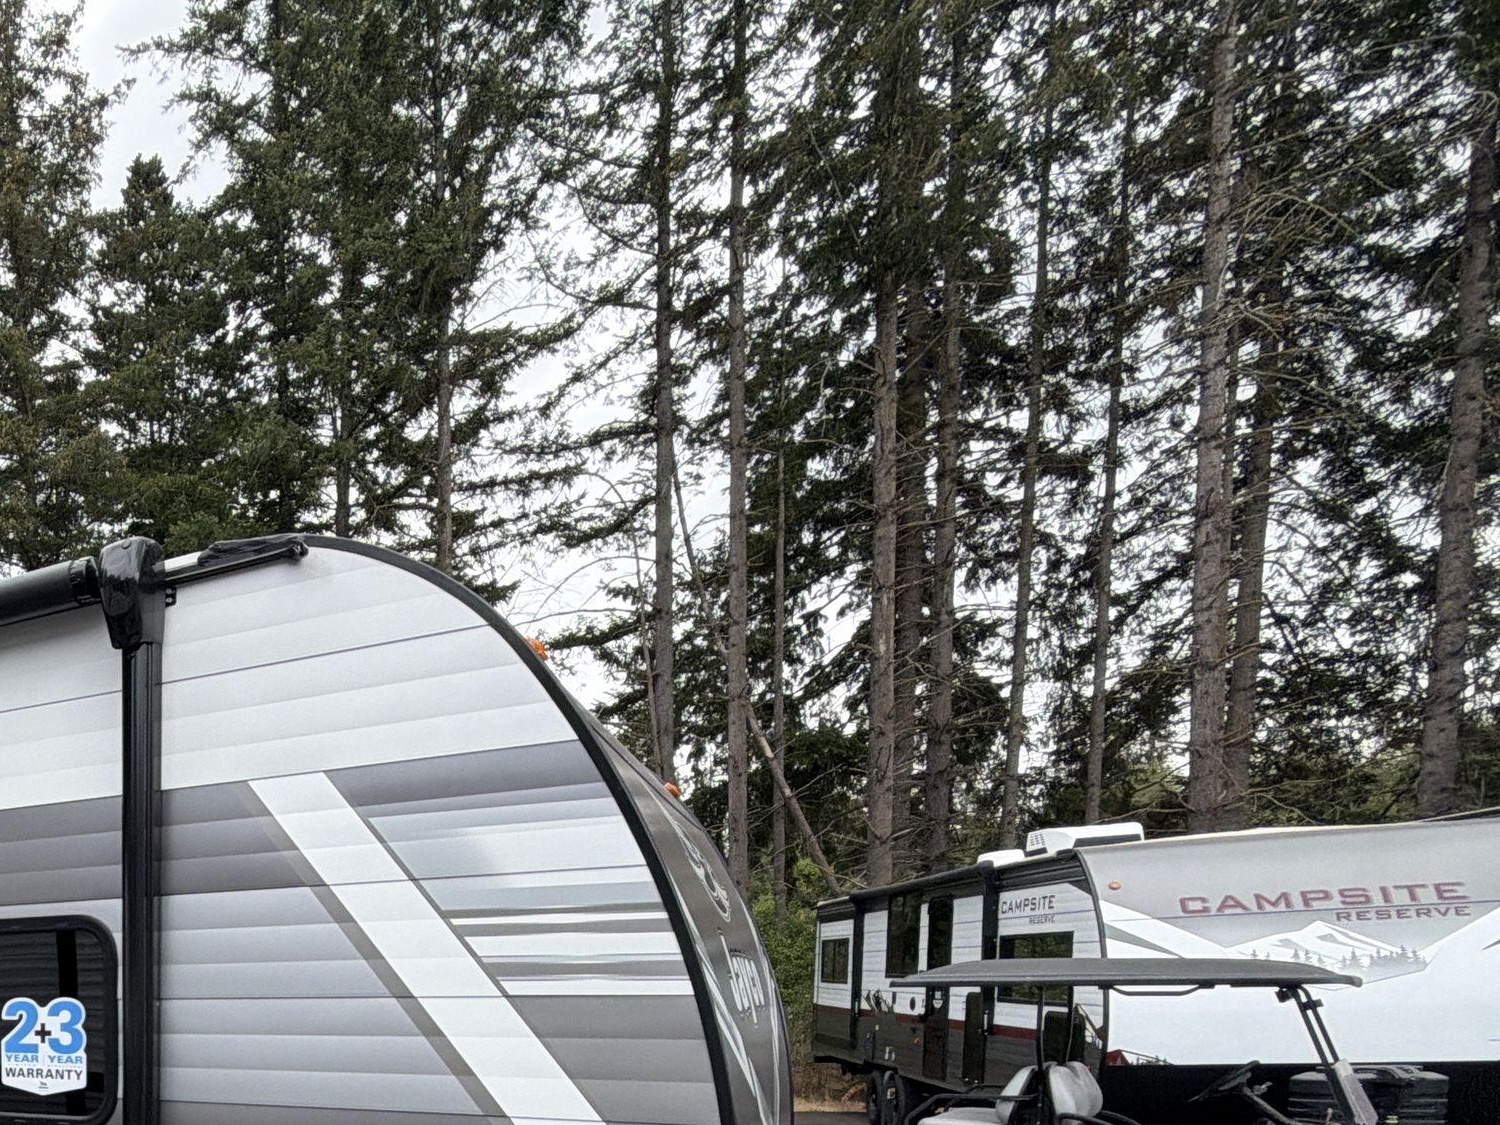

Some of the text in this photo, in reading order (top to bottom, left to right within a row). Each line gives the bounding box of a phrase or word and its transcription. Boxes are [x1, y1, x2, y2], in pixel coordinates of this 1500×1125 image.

[1001, 894, 1055, 914] CAMPSITE
[1179, 881, 1471, 915] CAMPSITE
[1335, 905, 1472, 922] RESERVE
[5, 1054, 83, 1064] YEAR YEAR
[5, 1067, 83, 1080] WARRANTY
